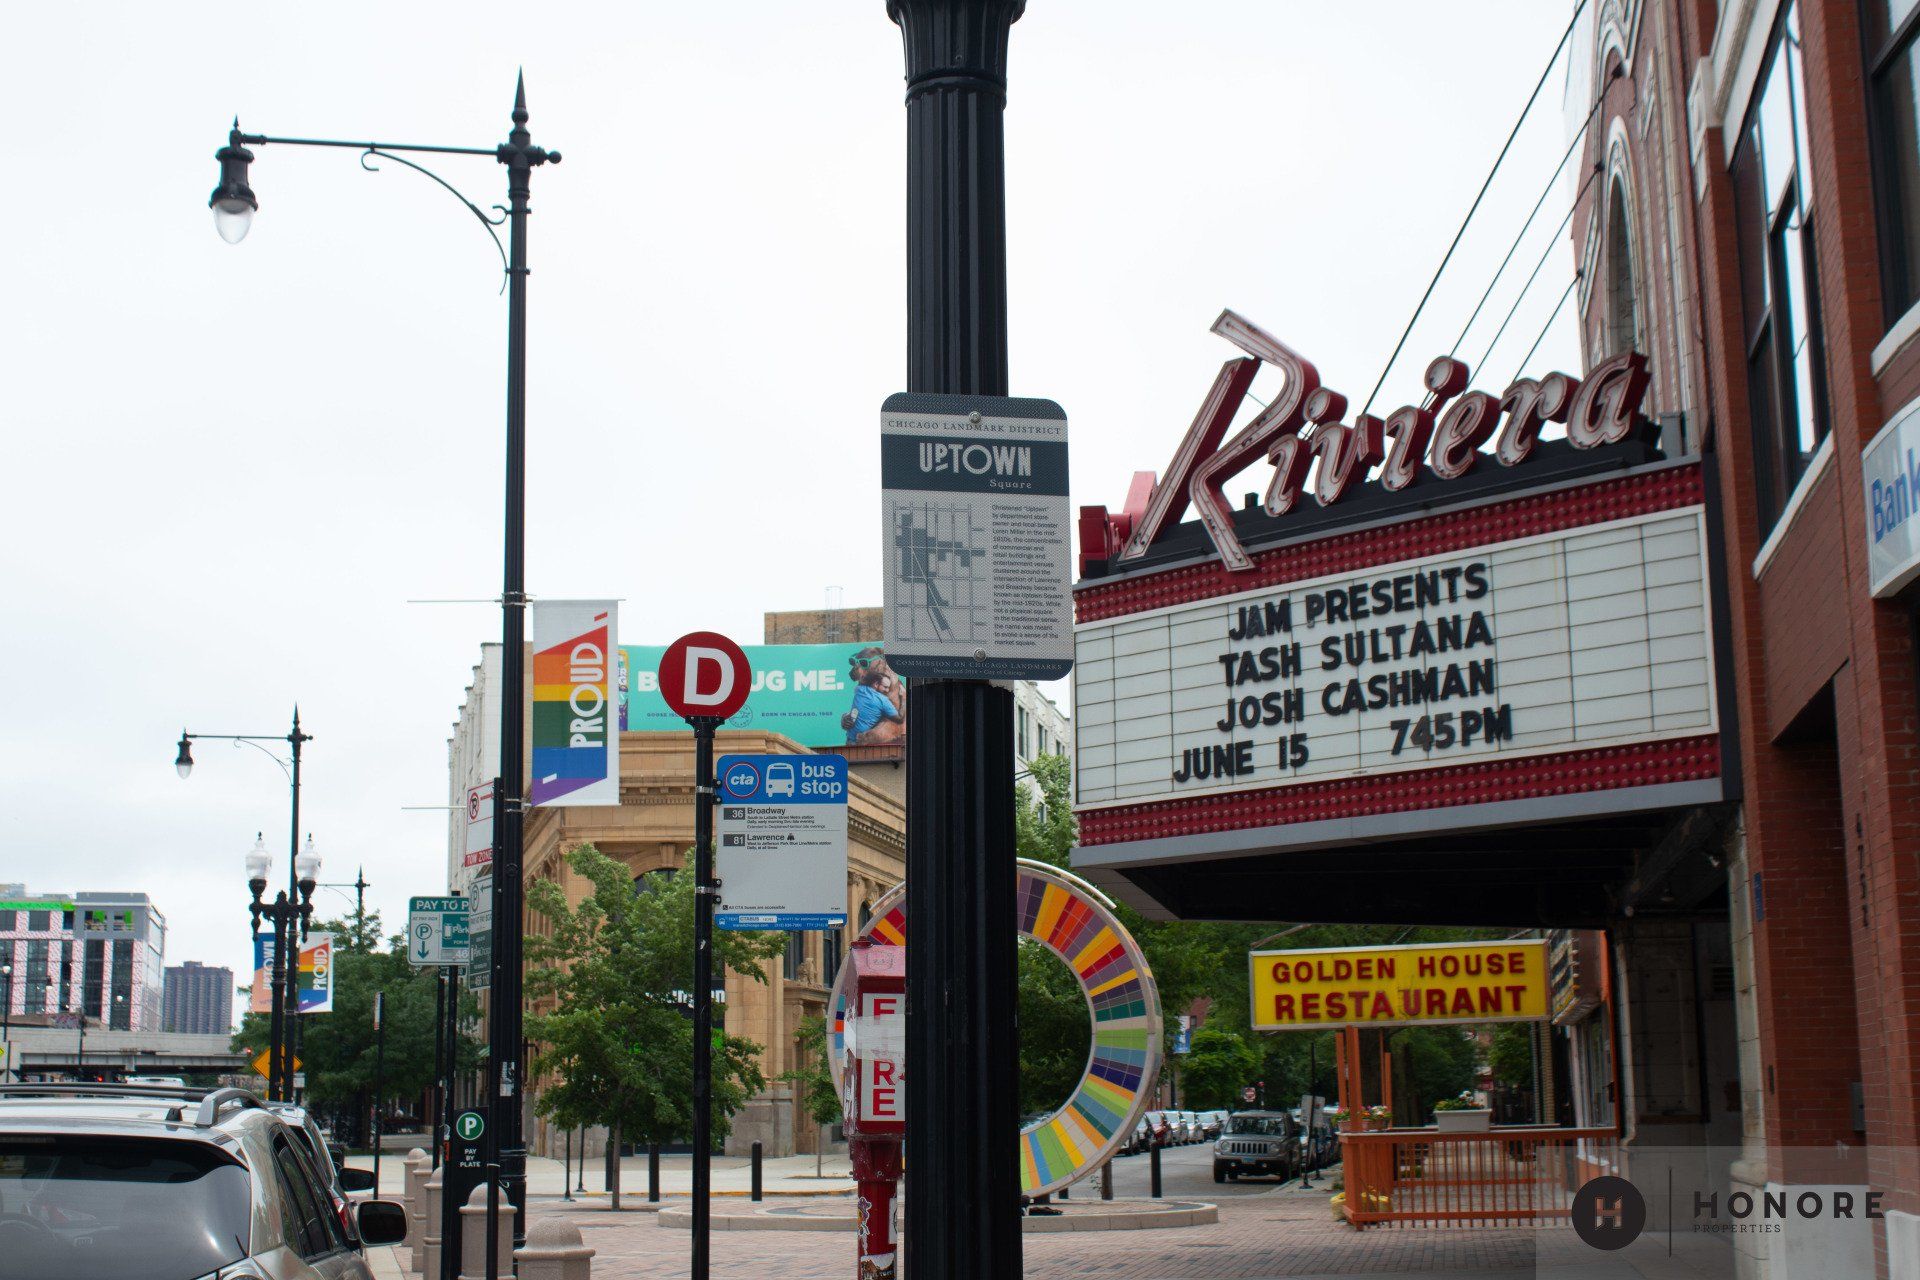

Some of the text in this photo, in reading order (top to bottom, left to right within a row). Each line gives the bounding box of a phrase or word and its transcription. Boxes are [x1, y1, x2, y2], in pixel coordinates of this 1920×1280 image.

[889, 420, 1061, 435] CHICAGO LANDMARK DISTRICT
[1117, 308, 1651, 573] Riviera
[919, 442, 1032, 477] UPTOWN
[989, 478, 1032, 489] Square
[1229, 562, 1490, 642] JAM PRESENTS
[896, 660, 950, 668] COMMISSION
[1219, 610, 1495, 690] TASH SULTANA
[683, 646, 734, 706] D
[794, 669, 844, 692] ME.
[570, 642, 604, 748] PROUD
[1216, 659, 1496, 733] JOSH CASHMAN
[801, 762, 835, 778] bus
[1172, 733, 1309, 784] JUNE 15
[731, 773, 754, 786] cta
[801, 779, 842, 798] stop
[732, 807, 785, 819] 36 Broadway
[416, 900, 469, 910] PAY TO P
[313, 948, 328, 991] PROUD
[1271, 952, 1526, 985] GOLDEN HOUSE
[1274, 985, 1528, 1021] RESTAURANT
[872, 998, 897, 1116] FRE
[465, 1117, 477, 1136] P
